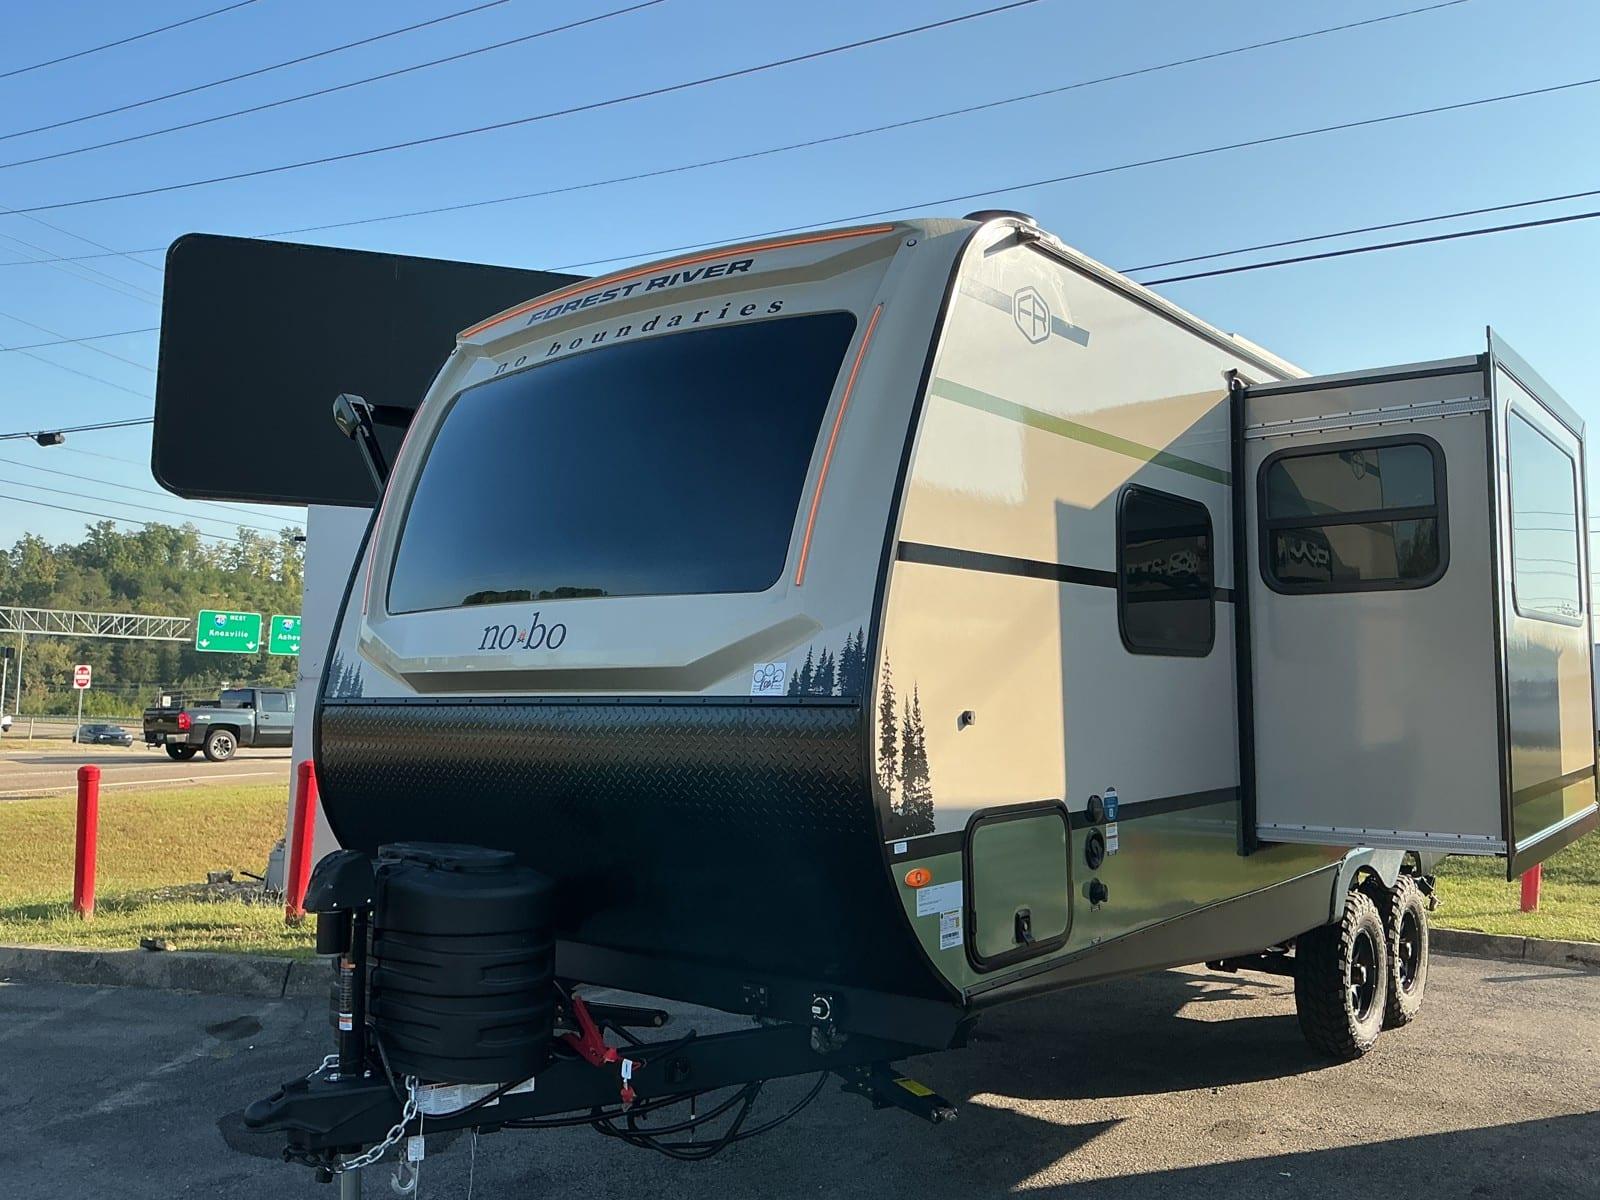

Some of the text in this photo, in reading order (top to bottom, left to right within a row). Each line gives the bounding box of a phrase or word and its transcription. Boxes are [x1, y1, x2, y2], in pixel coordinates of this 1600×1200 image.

[526, 258, 754, 326] FOREST RIVER
[495, 300, 784, 375] no boundaries
[209, 630, 248, 638] Knoxville
